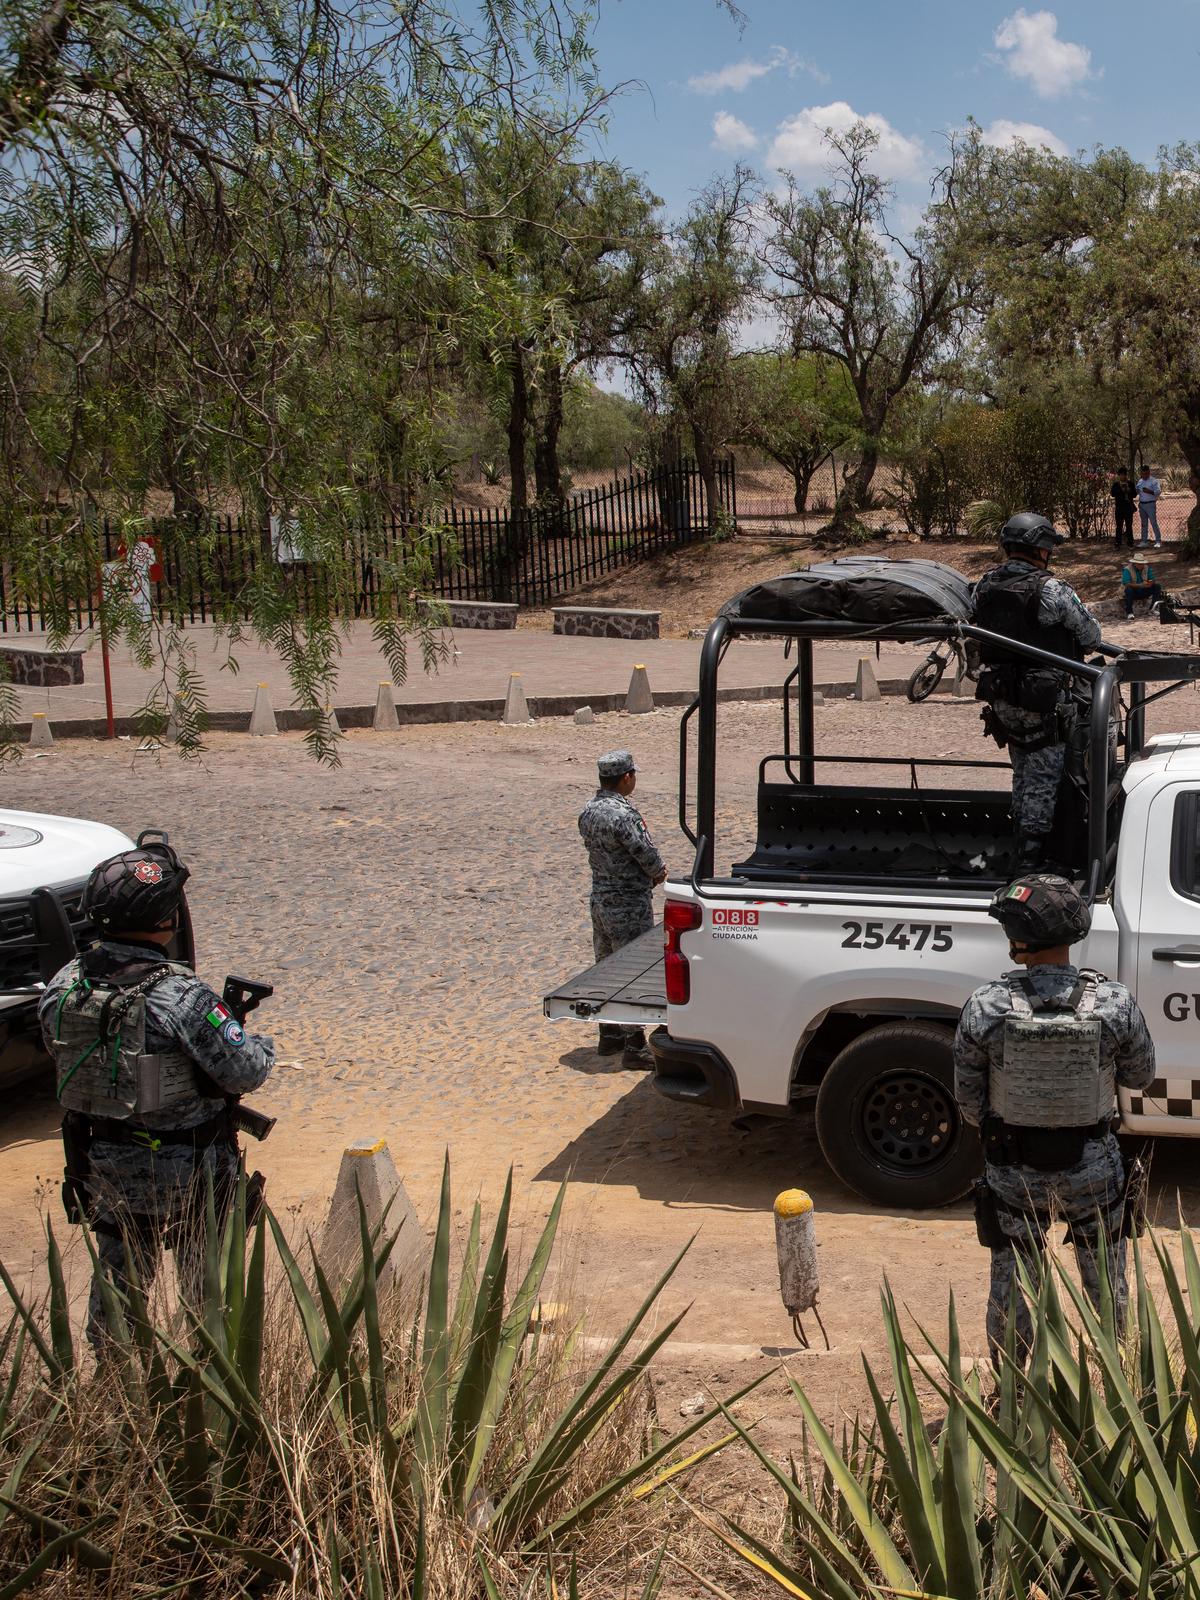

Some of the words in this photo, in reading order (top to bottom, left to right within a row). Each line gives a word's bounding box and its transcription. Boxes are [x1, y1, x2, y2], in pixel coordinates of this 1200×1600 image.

[714, 910, 756, 924] 088
[717, 924, 753, 932] ATENCIÓN
[712, 932, 758, 940] CIUDADANA
[841, 921, 953, 952] 25475
